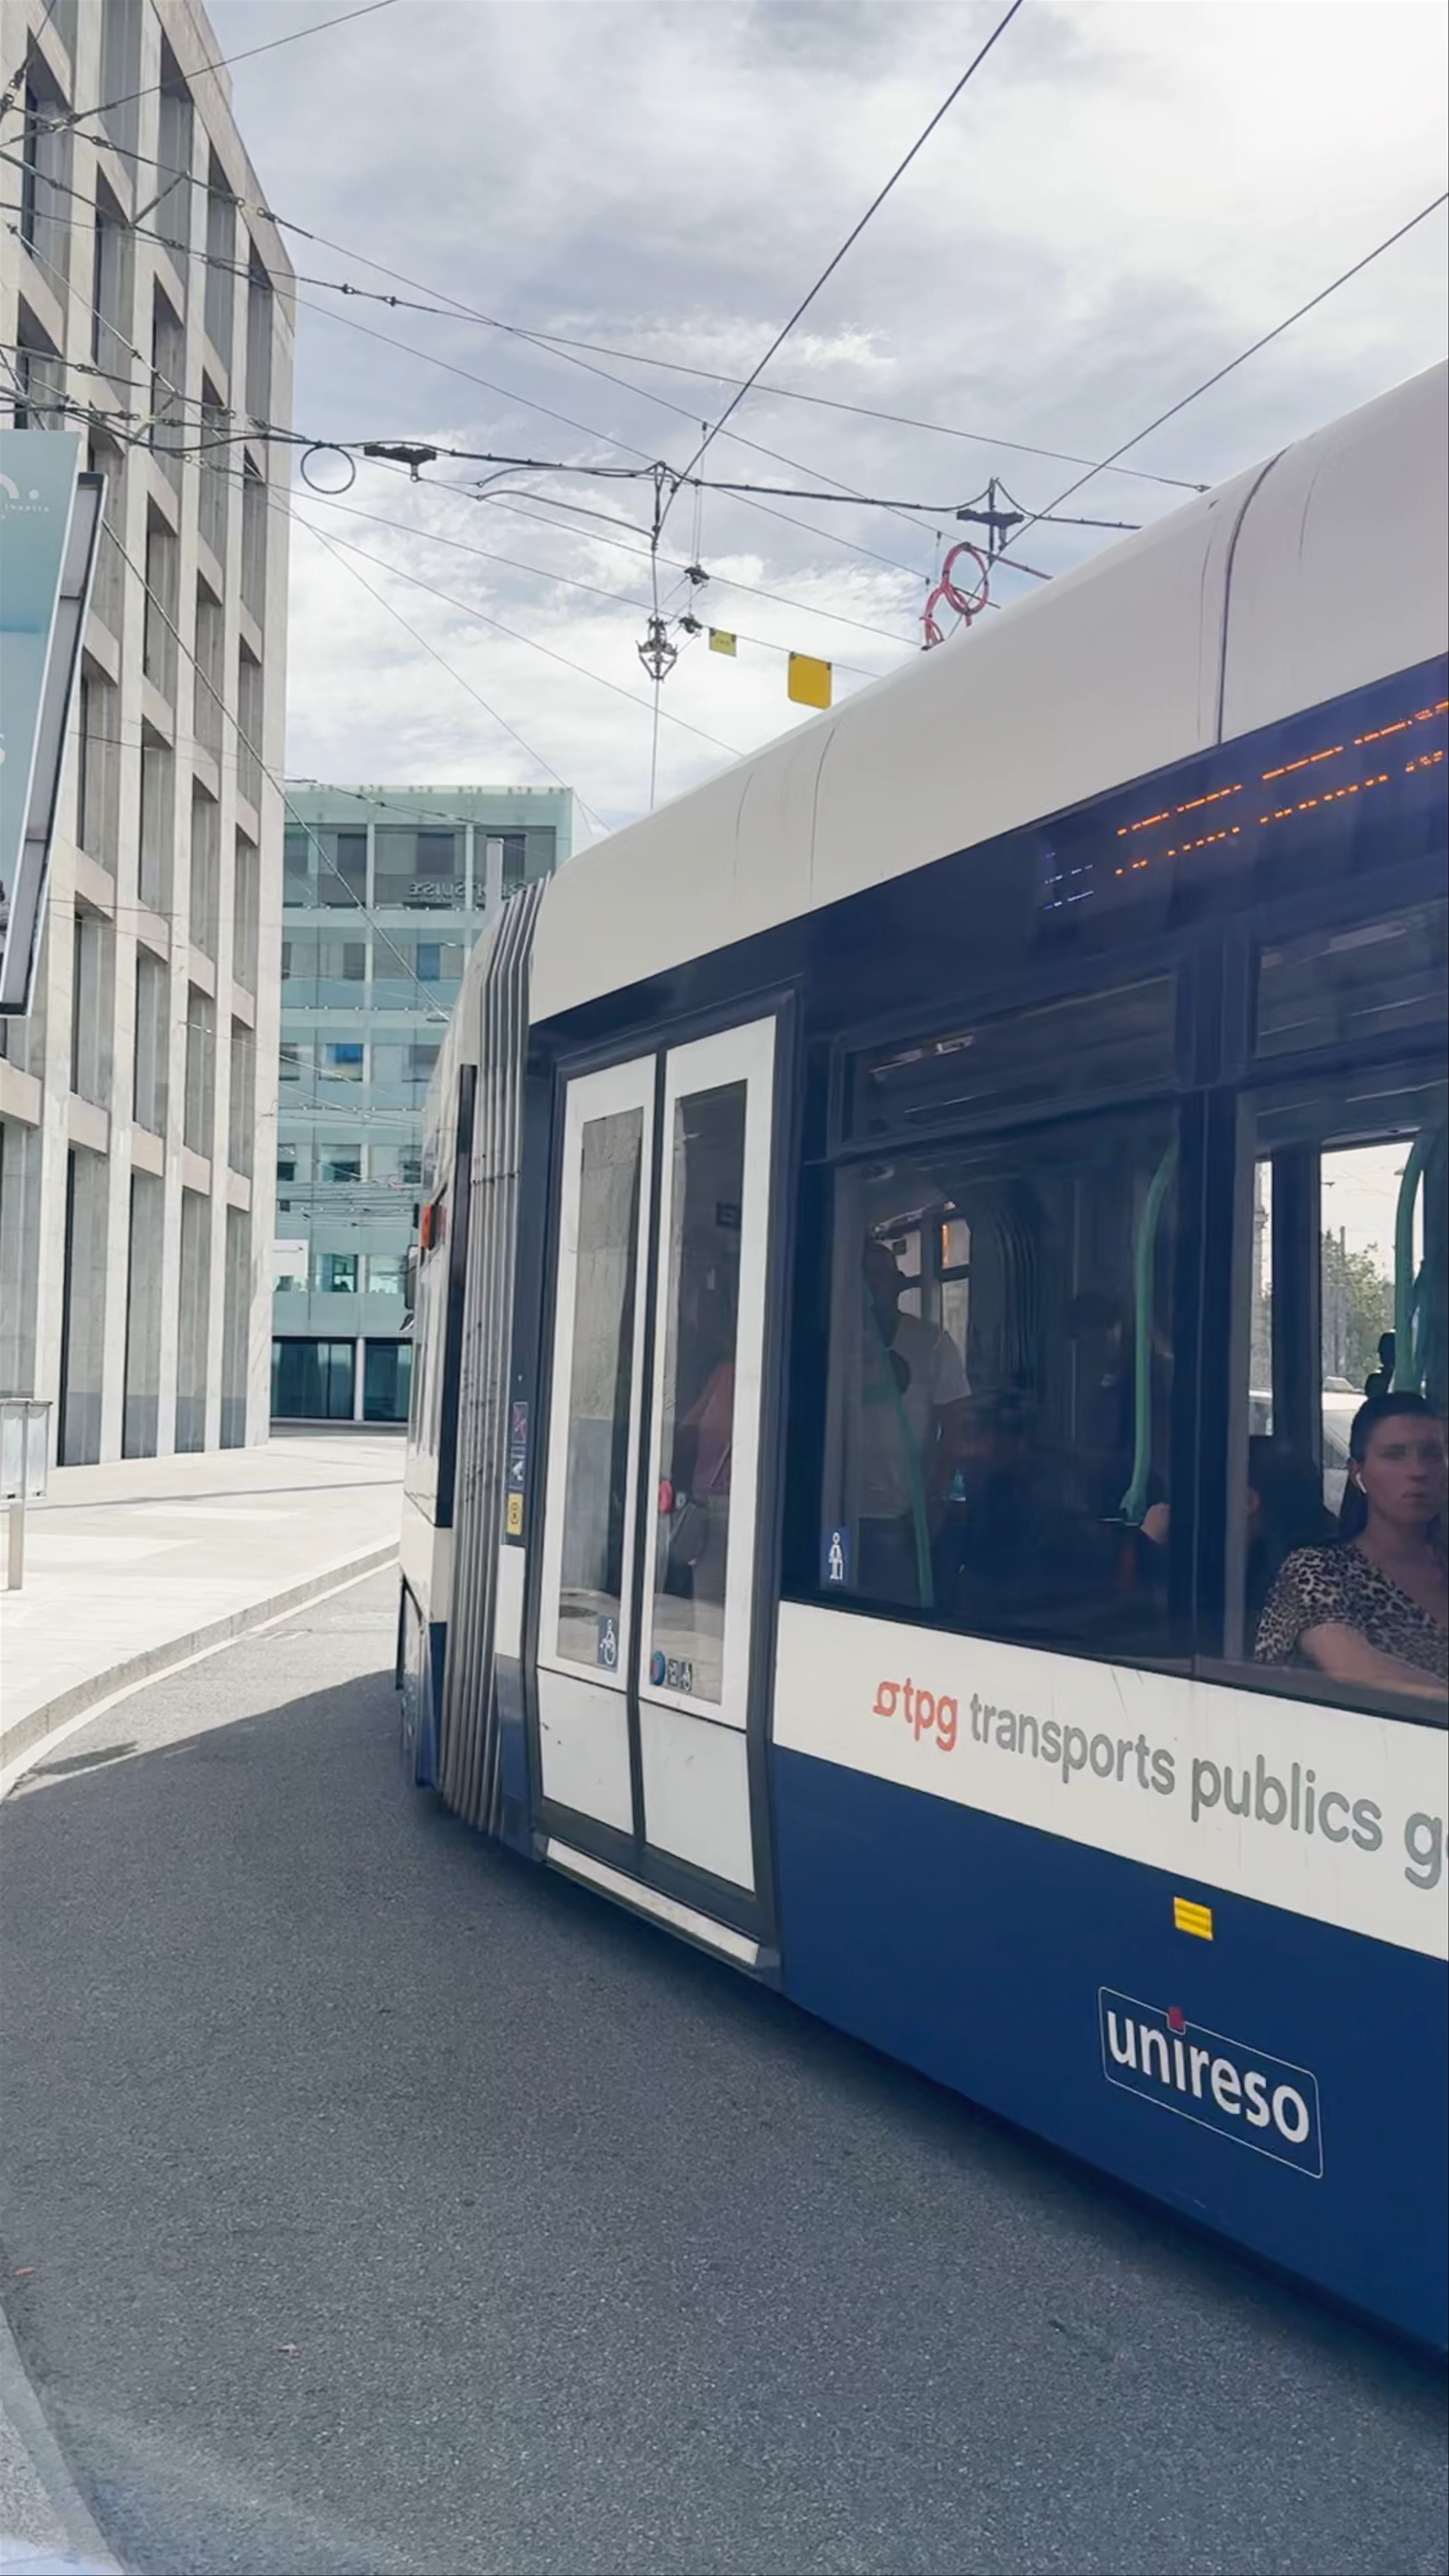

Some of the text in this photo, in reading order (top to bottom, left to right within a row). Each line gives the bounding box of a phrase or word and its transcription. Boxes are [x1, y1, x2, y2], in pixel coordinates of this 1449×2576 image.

[970, 1692, 1176, 1795] transports
[1192, 1754, 1383, 1852] publics
[1404, 1812, 1449, 1890] g
[1107, 2006, 1310, 2143] unireso
